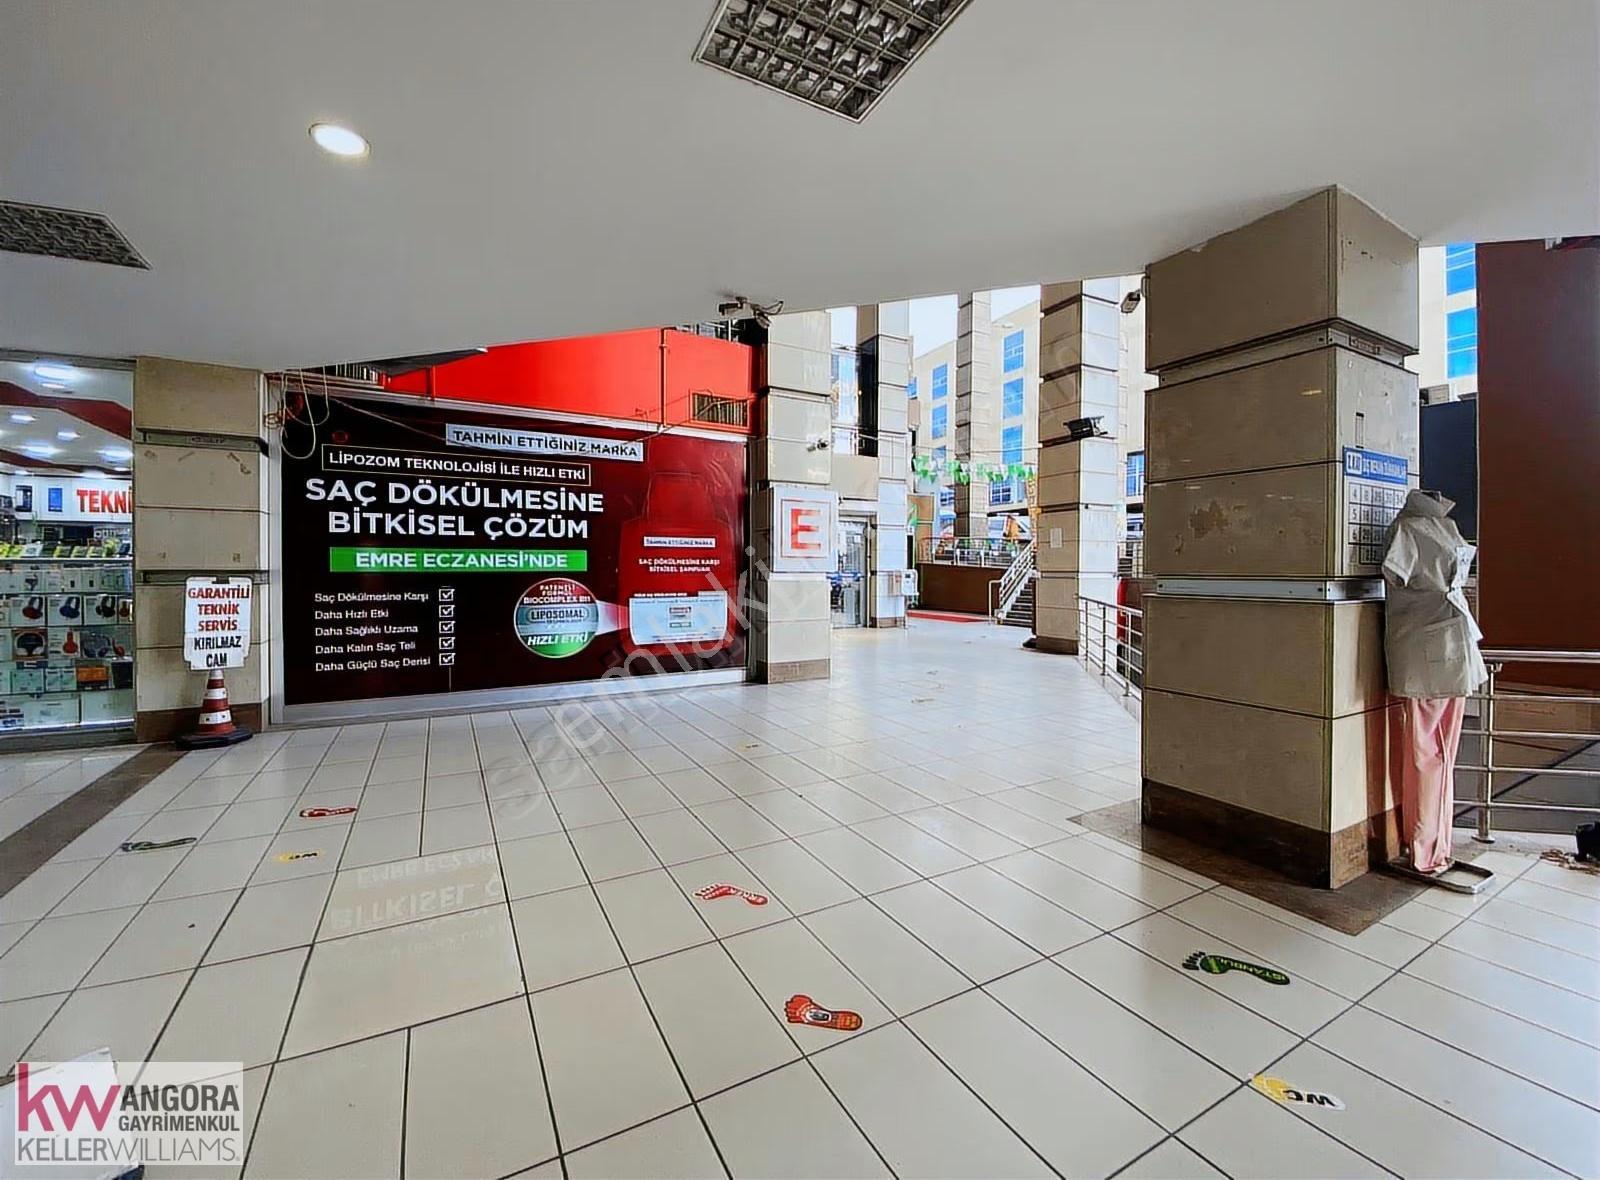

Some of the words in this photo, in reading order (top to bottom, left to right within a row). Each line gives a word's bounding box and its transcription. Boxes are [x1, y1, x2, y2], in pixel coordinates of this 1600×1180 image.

[453, 430, 513, 446] TAHMİN
[517, 431, 587, 453] ETTİĞİNİZ
[590, 443, 638, 457] MARKA
[329, 450, 400, 469] LİPOZOM
[403, 457, 497, 475] TEKNOLOJİSİ
[499, 461, 521, 476] İLE
[523, 464, 555, 479] HIZLI
[558, 467, 587, 481] ETKİ
[306, 478, 377, 507] SAÇ
[388, 478, 605, 512] DÖKÜLMESİNE
[328, 507, 475, 536] BİTKİSEL
[483, 512, 589, 541] ÇÖZÜM
[790, 508, 821, 549] E
[356, 552, 416, 568] EMRE
[423, 550, 568, 569] ECZANESİ'NDE
[188, 584, 250, 600] GARANTİLİ
[315, 592, 335, 604] Saç
[197, 601, 240, 616] TEKNİK
[315, 610, 343, 620] Daha
[370, 609, 389, 619] Etki
[531, 608, 585, 620] LIPOSOMAL
[198, 617, 238, 632] SERVİS
[315, 627, 343, 637] Daha
[194, 636, 242, 650] KIRILMAZ
[527, 635, 559, 646] HIZLI
[560, 632, 588, 644] ETKİ
[315, 645, 344, 655] Daha
[376, 642, 396, 653] Saç
[399, 641, 416, 651] Teli
[205, 653, 227, 668] CAM
[315, 663, 344, 672] Daha
[380, 659, 400, 670] Saç
[402, 657, 431, 667] Derisi
[1282, 1088, 1337, 1108] WC
